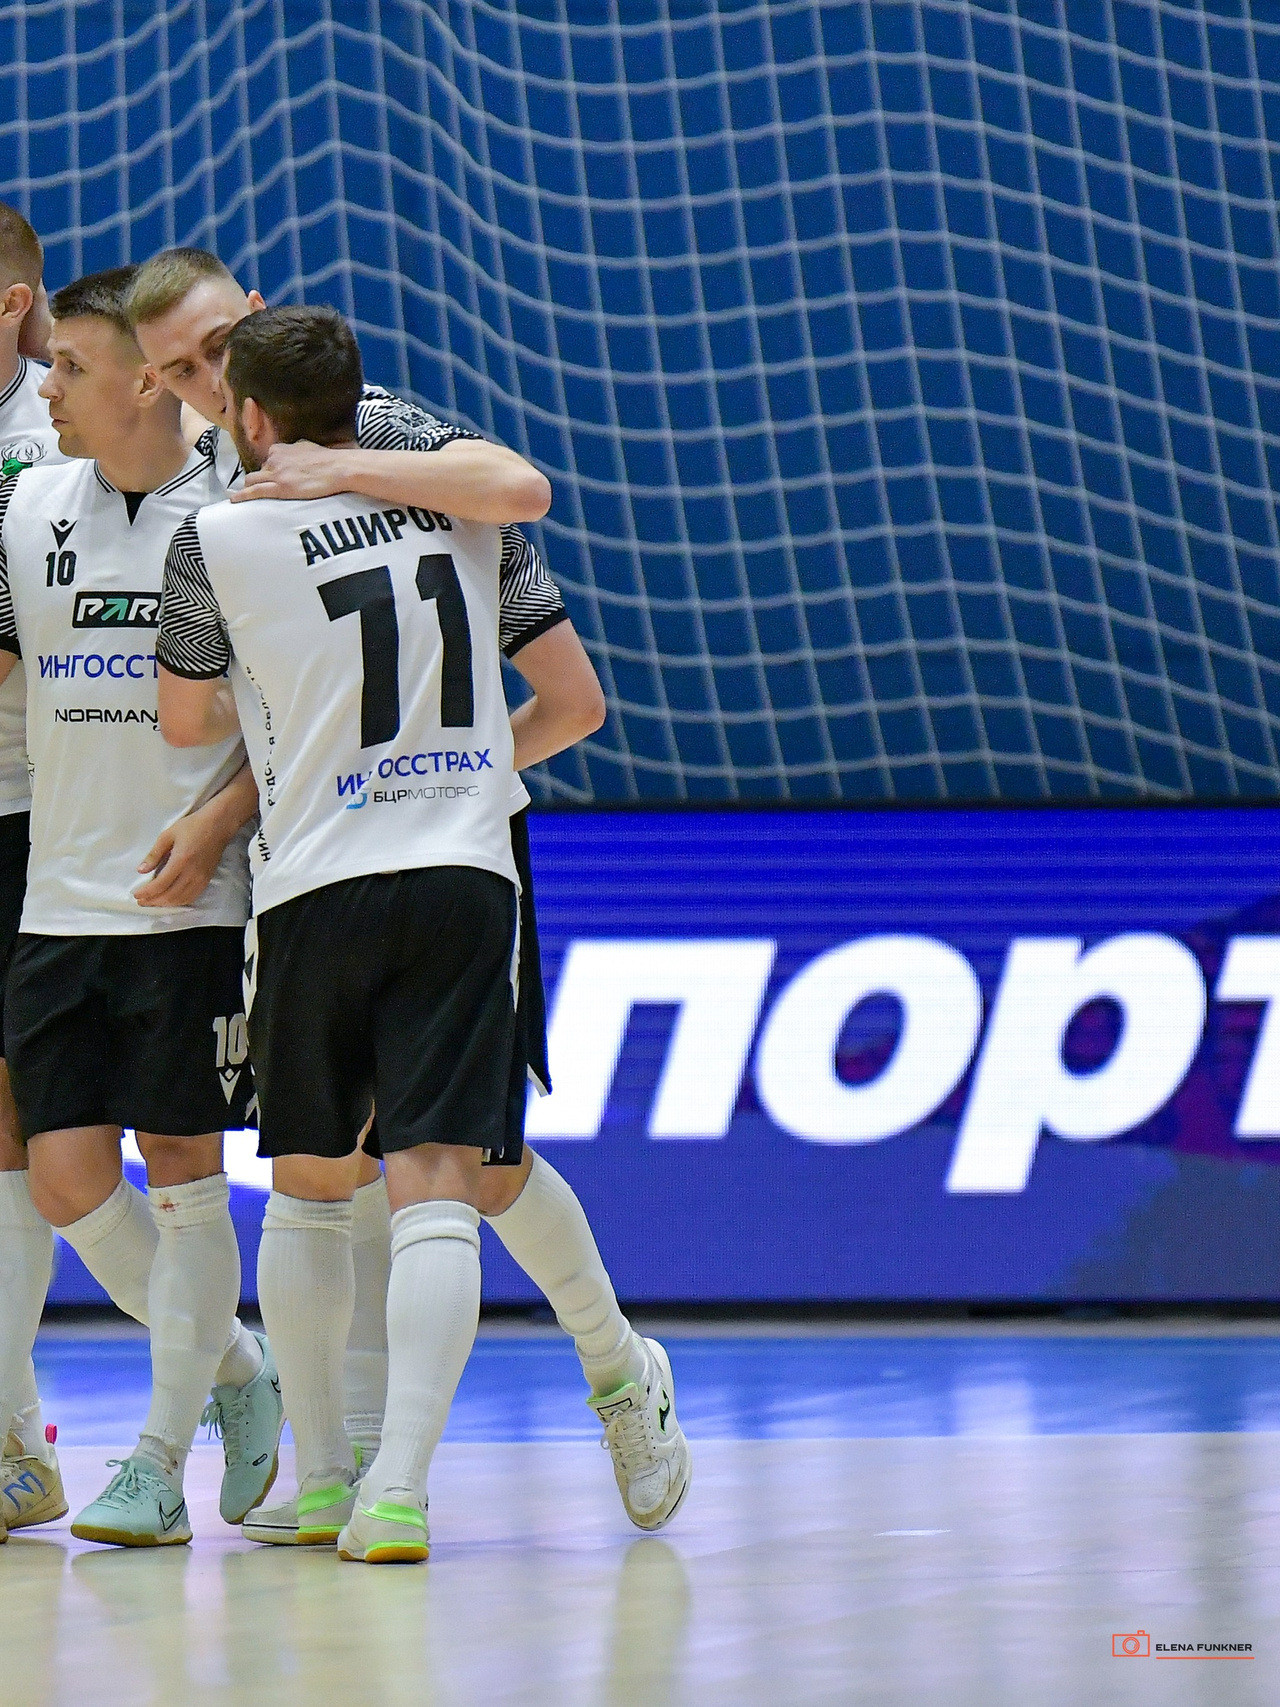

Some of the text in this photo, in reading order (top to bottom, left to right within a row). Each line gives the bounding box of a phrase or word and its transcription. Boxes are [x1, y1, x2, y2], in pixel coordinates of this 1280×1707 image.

[298, 505, 453, 566] АШИРОВ
[45, 550, 78, 587] 10
[37, 654, 158, 679] ИНГОССТ
[316, 553, 474, 749] 71
[336, 748, 494, 797] ИНОССТРАХ
[212, 1012, 249, 1068] 10
